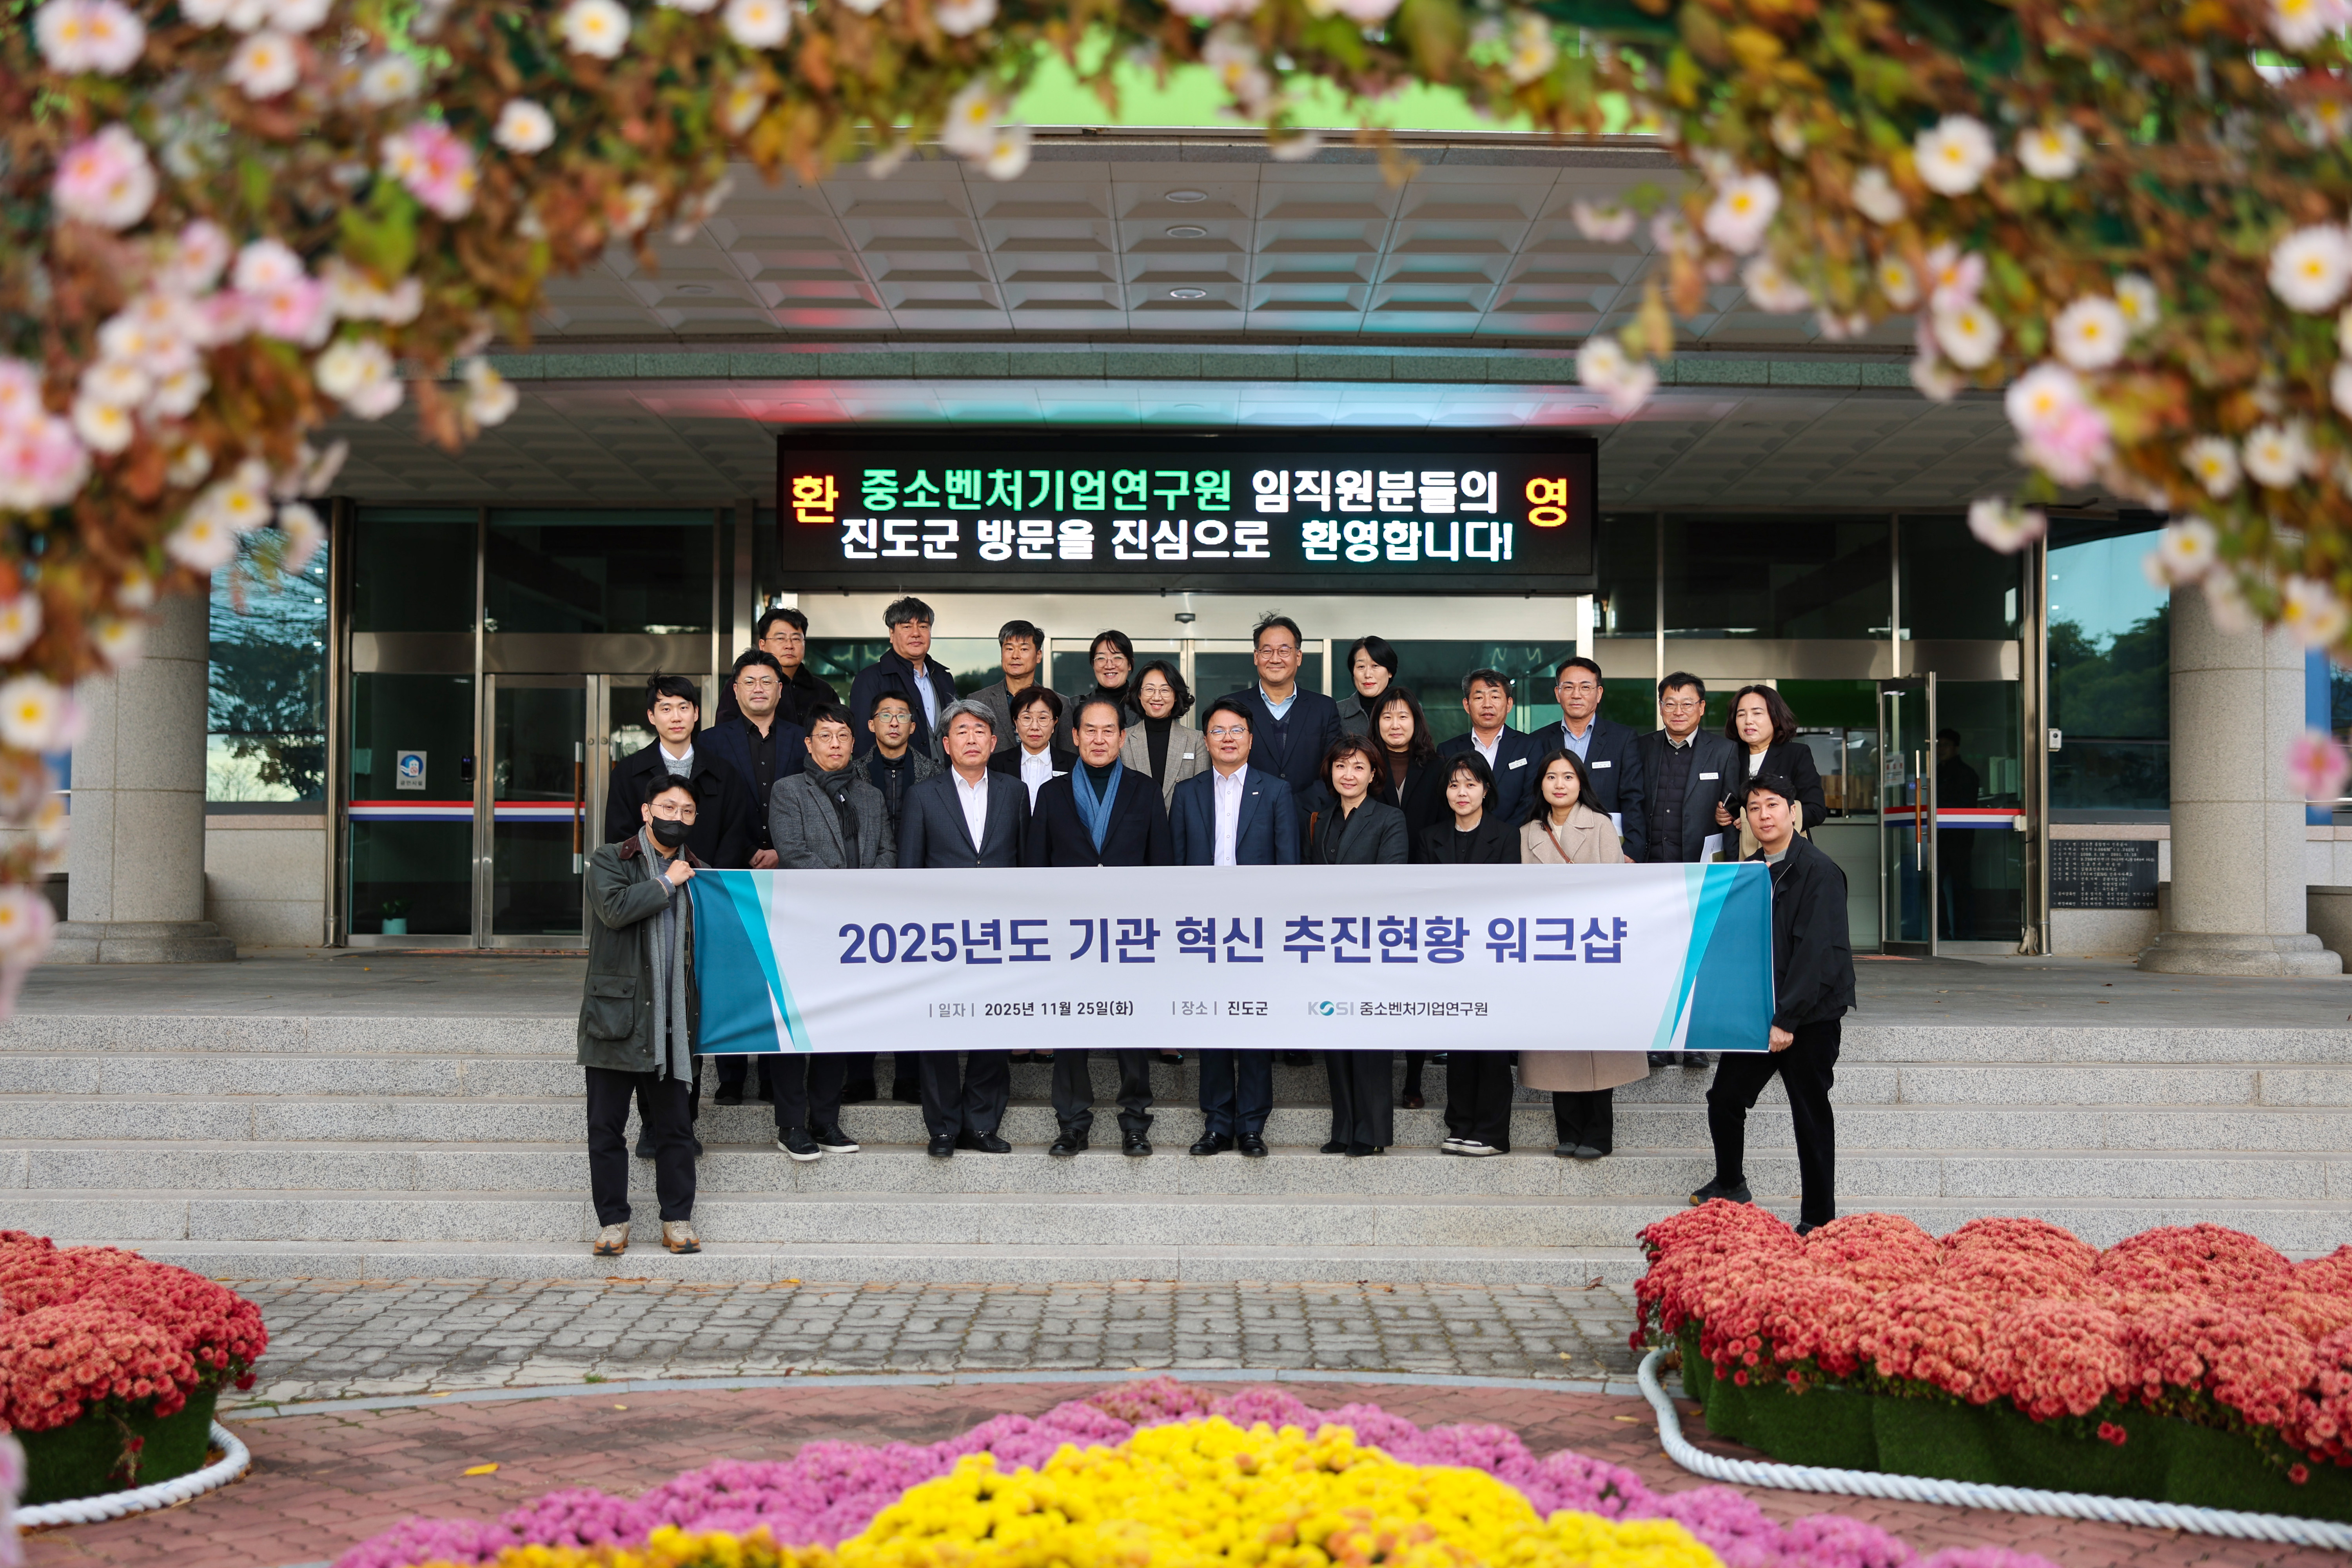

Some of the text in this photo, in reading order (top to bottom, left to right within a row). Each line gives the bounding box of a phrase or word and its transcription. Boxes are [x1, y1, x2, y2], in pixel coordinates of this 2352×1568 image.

[792, 475, 838, 523] 환
[861, 468, 1497, 514] 중소벤처기업연구원 임직원분들의
[1526, 477, 1567, 527] 영
[840, 518, 1513, 563] 진도군 방문을 진심으로 환영합니다!
[838, 915, 1628, 965] 2025년도 기관 혁신 추진현황 워크샵
[985, 1002, 1034, 1016] 2025년
[1041, 1001, 1071, 1016] 11월
[1077, 1000, 1134, 1016] 25일(화)
[1228, 1001, 1268, 1016] 진도군
[1308, 1000, 1488, 1016] KOSI 중소벤처기업연구원
